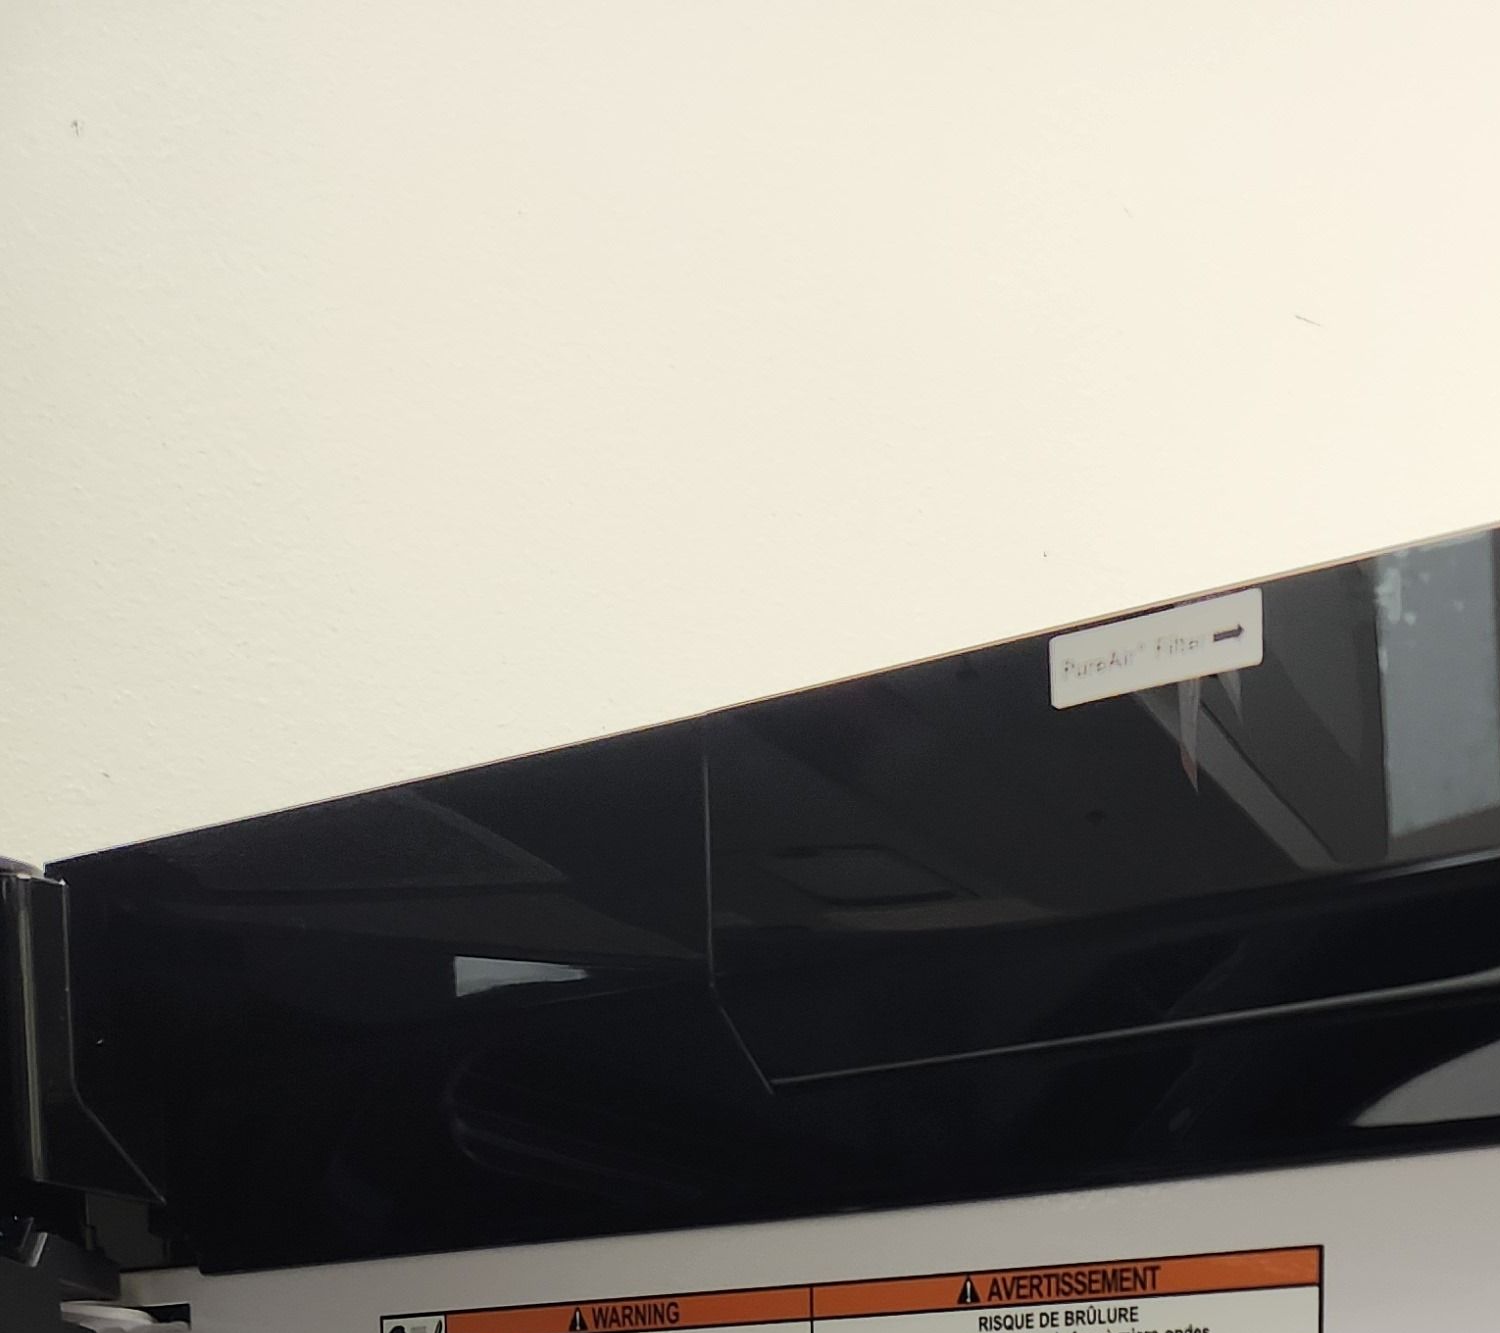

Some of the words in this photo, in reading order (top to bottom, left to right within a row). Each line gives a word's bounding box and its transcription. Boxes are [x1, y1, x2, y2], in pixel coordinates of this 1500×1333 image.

[988, 1266, 1161, 1302] AVERTISSEMENT
[592, 1302, 680, 1329] WARNING
[979, 1313, 1034, 1332] RISQUE
[1039, 1312, 1060, 1328] DE
[1064, 1305, 1139, 1327] BRÛLURE
